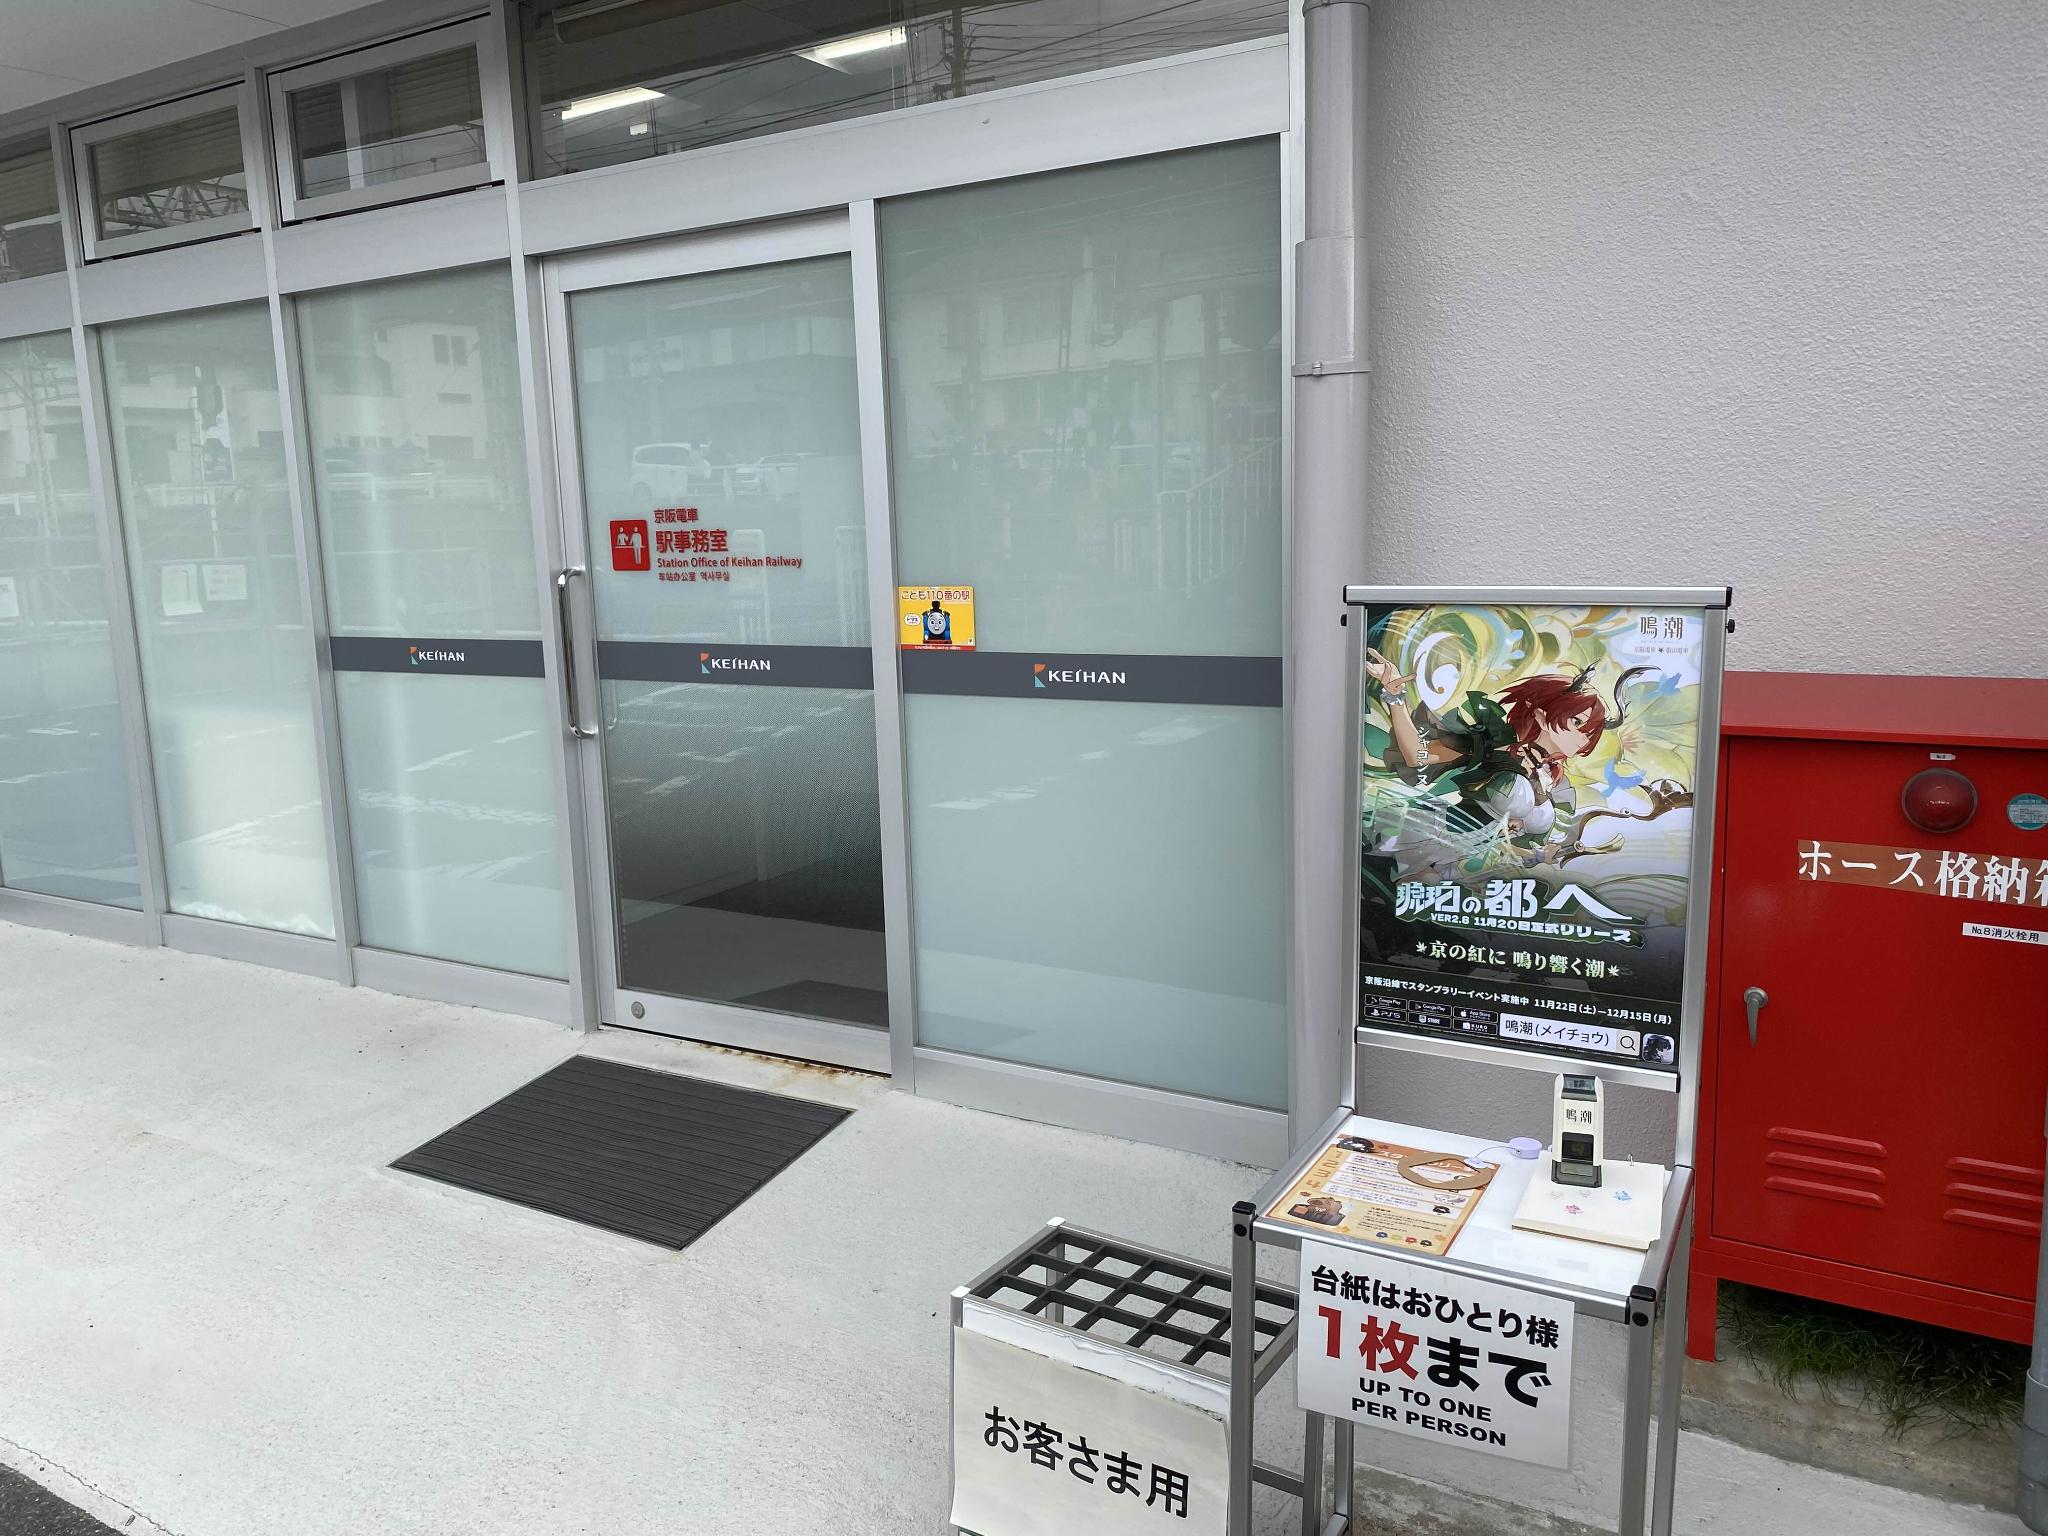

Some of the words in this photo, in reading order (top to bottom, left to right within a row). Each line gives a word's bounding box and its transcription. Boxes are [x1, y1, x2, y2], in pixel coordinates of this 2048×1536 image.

[654, 508, 699, 524] 京阪電車
[656, 529, 729, 553] 駅事務室
[657, 558, 688, 568] Station
[690, 557, 717, 568] Office
[720, 557, 729, 567] of
[731, 557, 763, 567] Keihan
[765, 556, 802, 568] Railway
[1640, 616, 1683, 640] 鳴潮
[418, 650, 465, 662] KEIHAN
[711, 658, 771, 671] KEIHAN
[1048, 669, 1126, 684] KEIHAN
[1416, 726, 1430, 786] シャコンヌ
[1395, 879, 1633, 920] 琥珀の都へ
[1431, 912, 1470, 926] VER2.8
[1474, 916, 1632, 943] 11月20日正式リリース
[1428, 940, 1507, 966] 京の紅に
[1512, 951, 1606, 979] 鳴り響く潮
[1364, 975, 1530, 1006] 京阪沿線でスタンプラリーイベント実施中
[1311, 1264, 1559, 1349] 台紙はおひとり様
[1318, 1304, 1552, 1408] 1枚まで
[1359, 1377, 1391, 1396] UP
[1398, 1386, 1431, 1407] TO
[1439, 1397, 1492, 1422] ONE
[1351, 1397, 1398, 1421] PER
[1405, 1410, 1507, 1447] PERSON
[983, 1405, 1190, 1519] お客さま用
